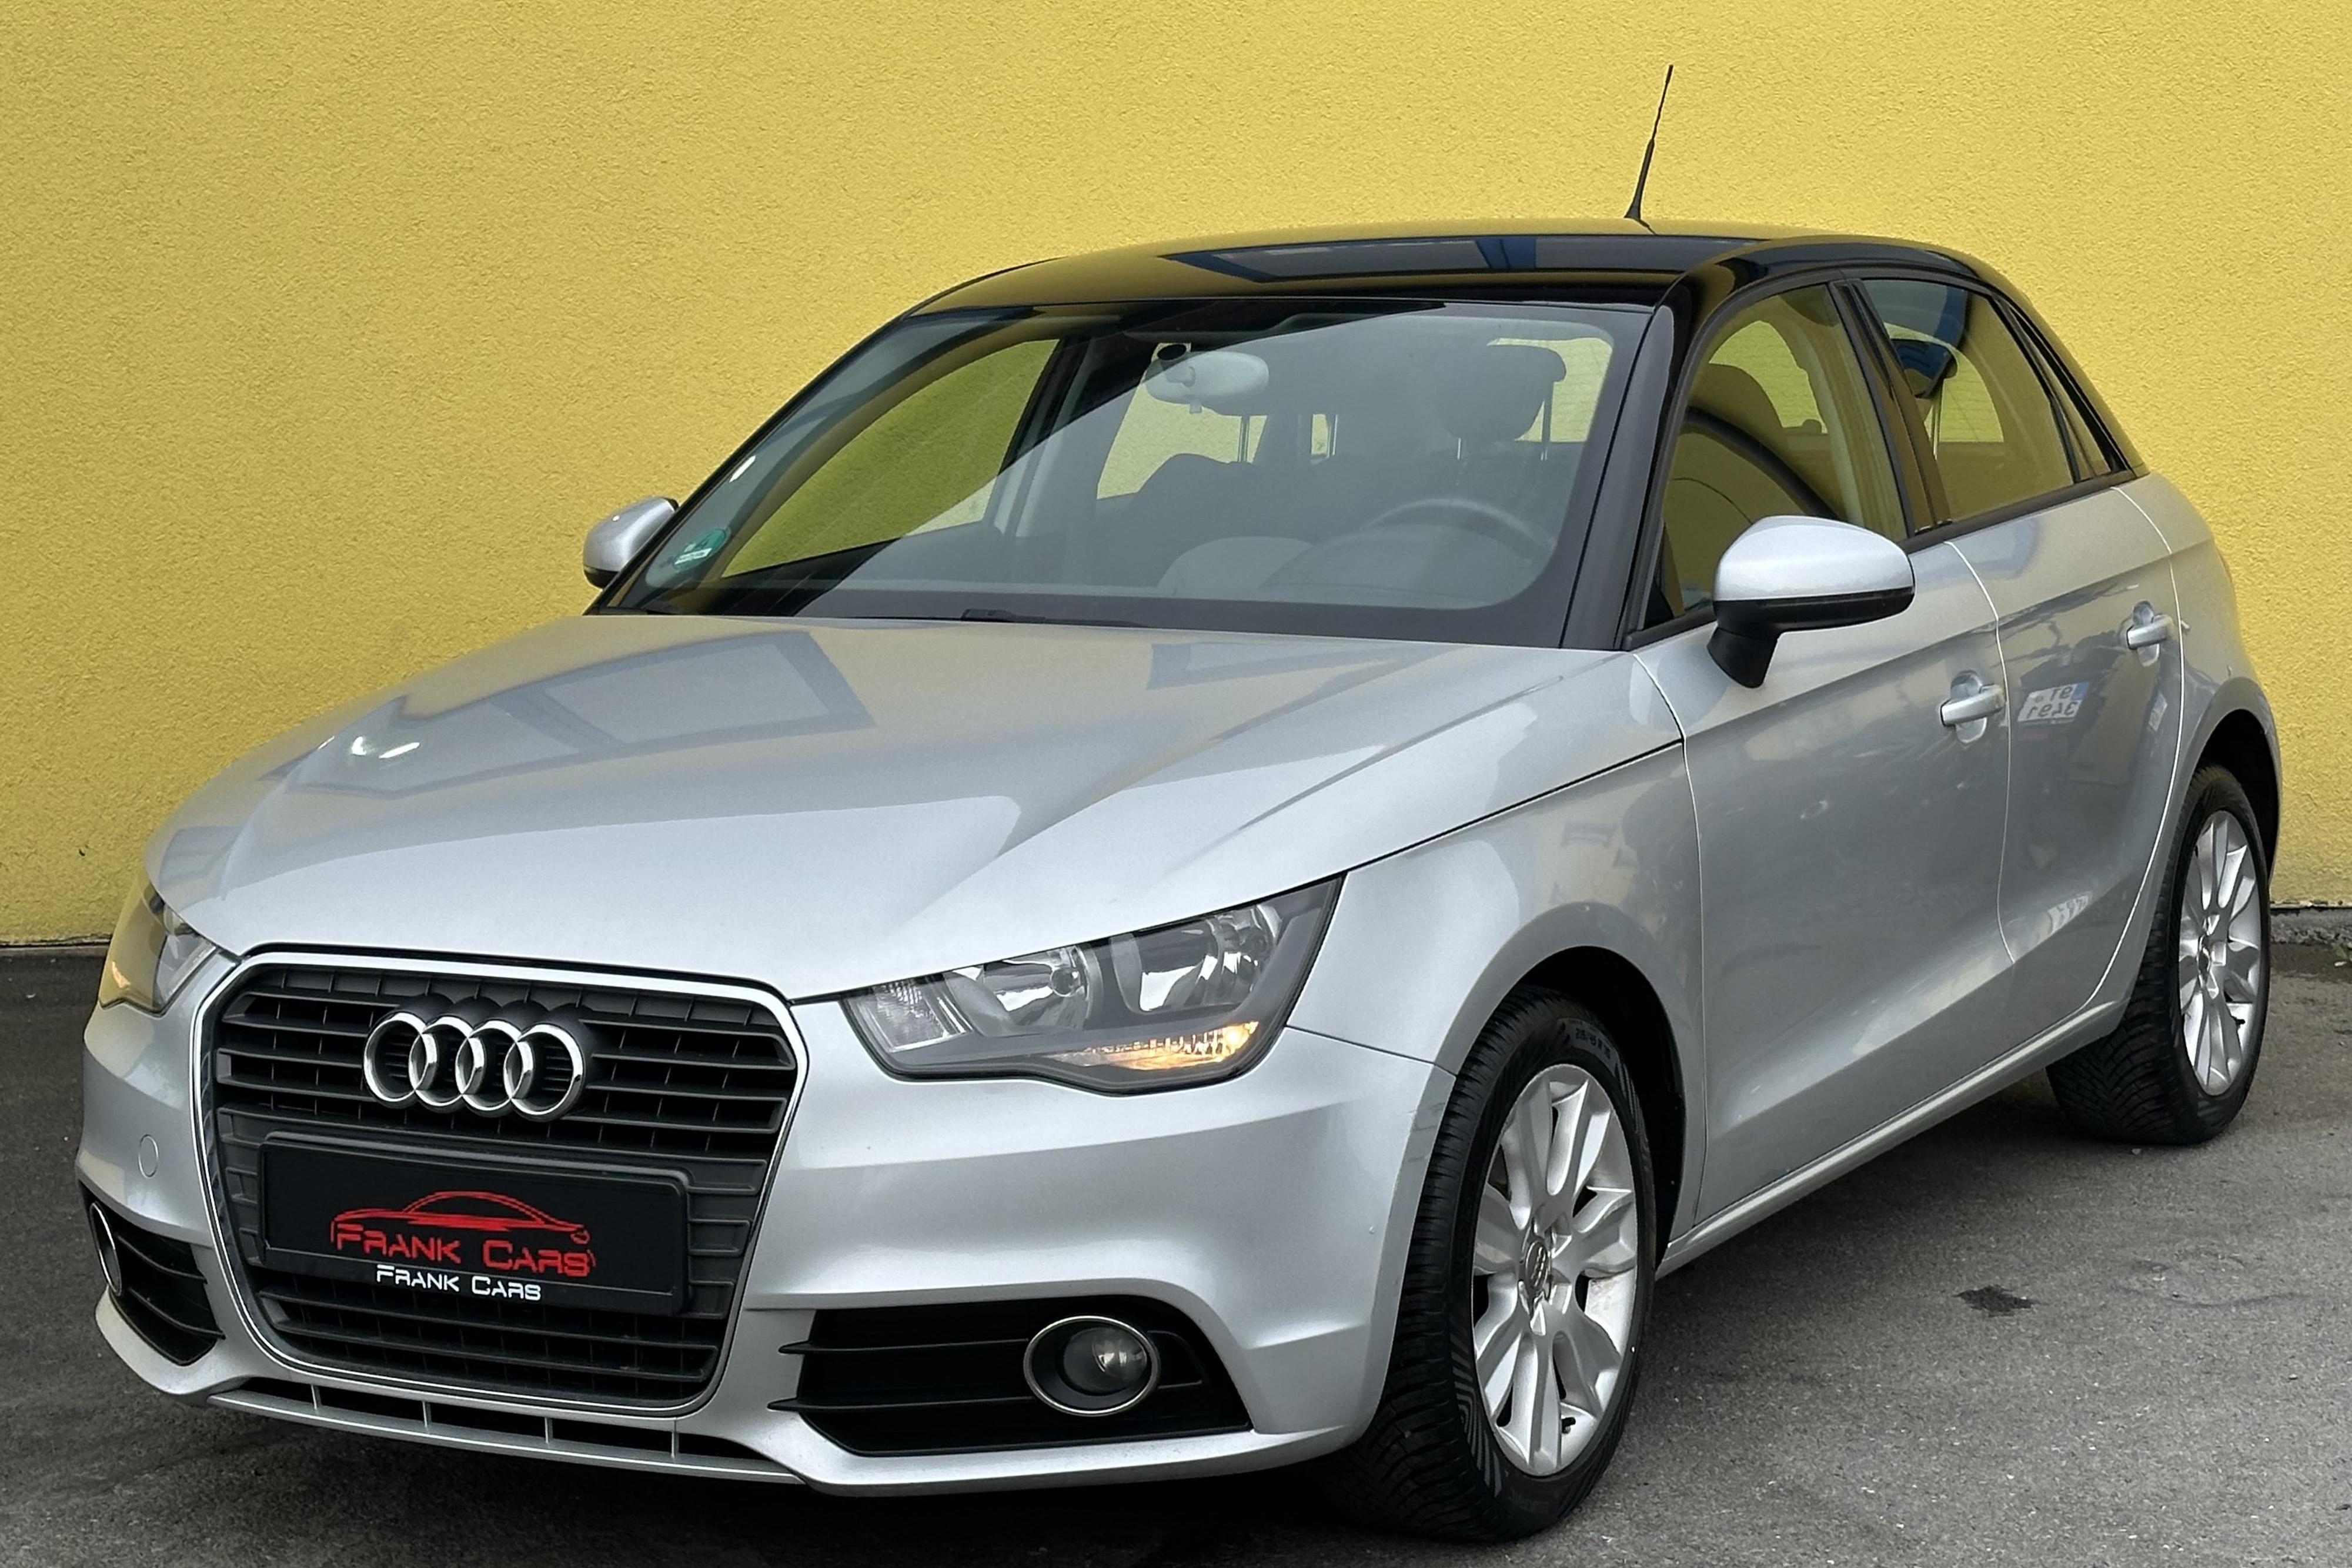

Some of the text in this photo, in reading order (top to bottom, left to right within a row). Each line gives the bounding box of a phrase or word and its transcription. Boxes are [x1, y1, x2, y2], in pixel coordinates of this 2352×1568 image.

[336, 1223, 591, 1278] FRANK CARS
[376, 1264, 542, 1301] FRANK CARS
